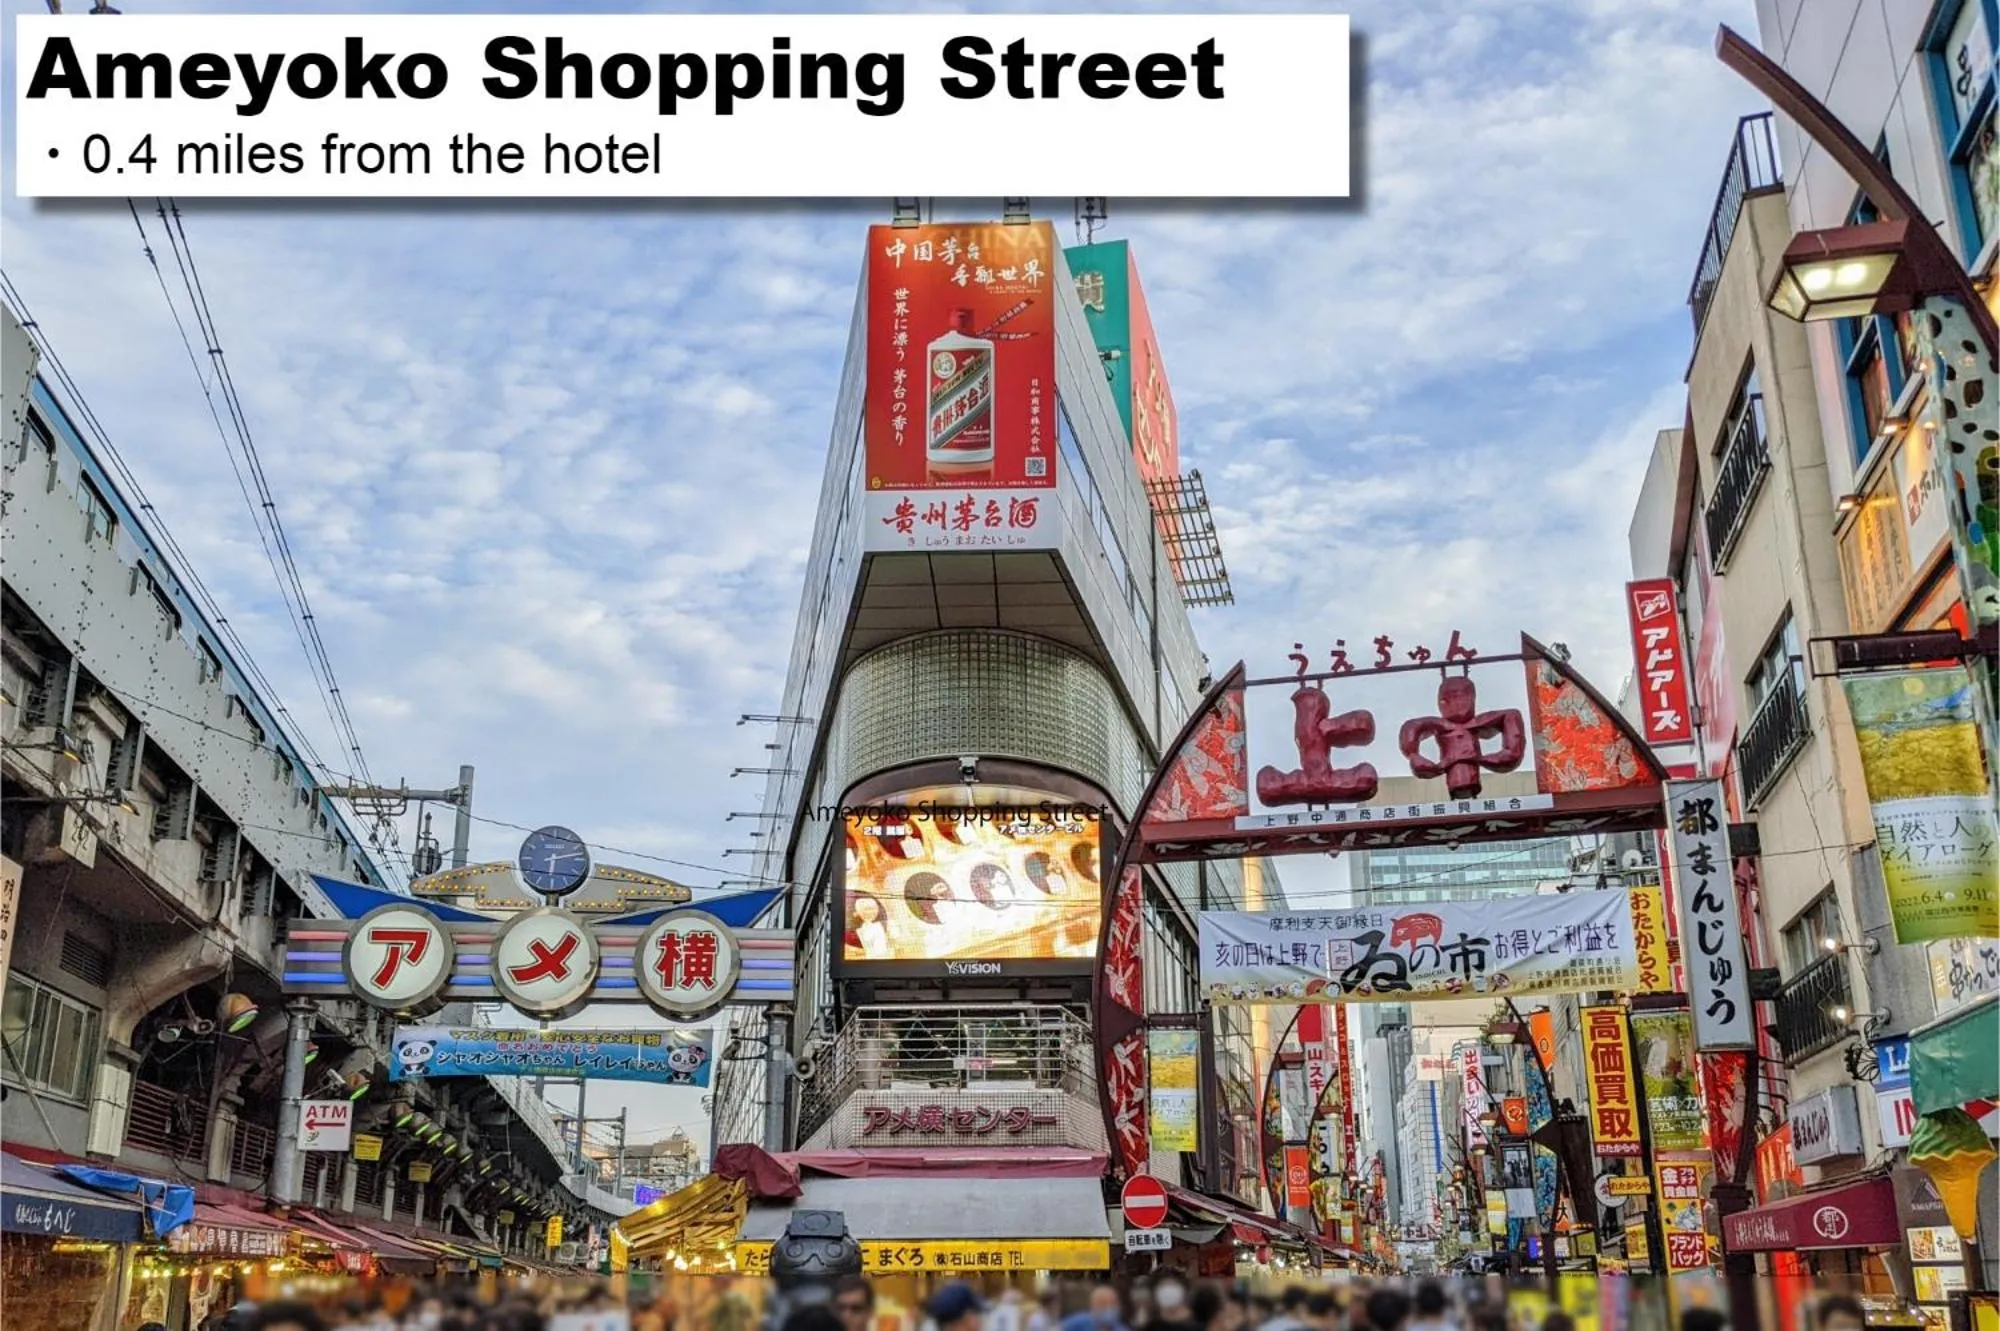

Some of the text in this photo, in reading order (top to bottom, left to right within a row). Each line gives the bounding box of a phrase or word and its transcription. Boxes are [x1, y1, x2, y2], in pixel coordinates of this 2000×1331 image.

[885, 237, 980, 268] 中国茅台
[1644, 627, 1681, 732] アドアーズ
[1256, 676, 1526, 806] 上中
[1676, 797, 1736, 1025] 都まんじゅう
[1215, 941, 1325, 969] 亥の日は上野で
[1494, 922, 1619, 959] お得とご利益を
[1631, 891, 1660, 990] おたからや
[368, 928, 718, 990] アメ横
[1587, 1010, 1633, 1138] 高価買取
[305, 1105, 348, 1118] ATM
[863, 1104, 1057, 1135] アメ横センター
[1596, 1143, 1640, 1153] おたからや
[1662, 1167, 1677, 1184] 金
[879, 1249, 924, 1266] まぐろ
[1009, 1251, 1024, 1266] TEL
[1669, 1235, 1703, 1250] ブランド
[1671, 1251, 1705, 1266] バッグ
